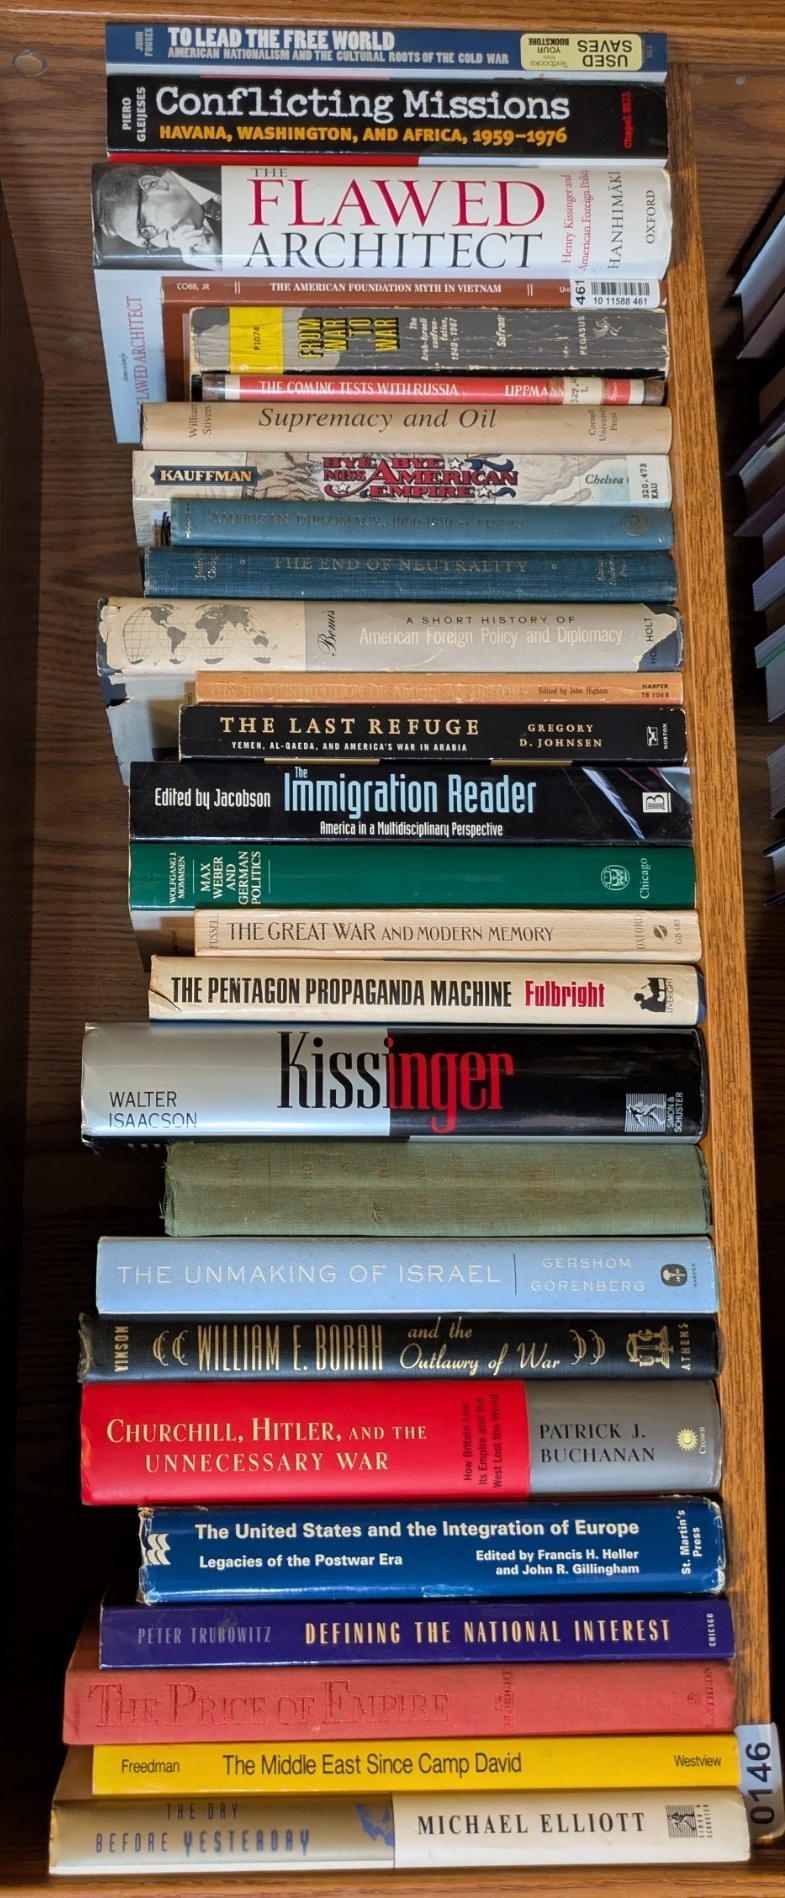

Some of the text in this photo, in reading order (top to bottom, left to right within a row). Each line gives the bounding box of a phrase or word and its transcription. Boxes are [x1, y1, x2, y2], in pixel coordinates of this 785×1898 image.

[168, 27, 395, 51] TO LEAD THE FREE WORLD
[528, 37, 570, 46] BOOKSTORE
[577, 39, 632, 67] USED SAVES
[122, 97, 132, 130] PIERO
[137, 87, 146, 142] GLEIJESES
[156, 87, 570, 124] Conflicting Missions
[159, 125, 233, 143] HAVANA,
[237, 127, 358, 144] WASHINGTON,
[362, 128, 398, 142] AND
[403, 129, 468, 144] AFRICA,
[251, 168, 288, 177] THE
[247, 178, 545, 227] FLAWED
[645, 189, 656, 244] OXFORD
[242, 232, 543, 269] ARCHITECT
[177, 282, 210, 292] COBB, JR
[575, 280, 586, 304] 461
[594, 297, 648, 306] 10 11588 461
[298, 317, 323, 359] FROM
[323, 317, 347, 352] WAR
[349, 317, 373, 337] TO
[375, 317, 400, 352] WAR
[189, 403, 198, 438] William
[202, 405, 212, 435] Stivers
[259, 407, 496, 433] Supremacy and Oil
[159, 470, 252, 482] KAUFFMAN
[323, 457, 445, 469] BYE BYE
[323, 459, 518, 486] MISS AMERICAN
[368, 485, 475, 498] EMPIRE
[585, 474, 624, 485] Chelsea
[317, 609, 337, 657] Bemis
[422, 616, 473, 624] SHORT
[481, 616, 547, 624] HISTORY
[557, 616, 575, 624] OF
[644, 617, 654, 642] HOLT
[220, 716, 479, 736] THE LAST REFUGE
[232, 741, 467, 751] YEMEN, AL-QAEDA, AND AMERICA'S WAR IN ARABIA
[295, 767, 308, 778] The
[284, 772, 537, 819] Immigration Reader
[320, 821, 503, 838] America in a Multidisciplinary Perspective
[200, 862, 211, 892] MAX
[213, 856, 223, 899] WEBER
[226, 863, 236, 891] AND
[238, 851, 249, 905] GERMAN
[251, 850, 261, 905] POLITICS
[639, 857, 650, 899] Chicago
[227, 922, 553, 942] THE GREAT WAR AND MODERN MEMORY
[171, 977, 605, 1008] THE PENTAGON PROPAGANDA MACHINE Fulbright
[277, 1031, 514, 1134] Kissinger
[109, 1091, 177, 1107] WALTER
[109, 1112, 197, 1128] ISAACSON
[675, 1092, 683, 1133] SCHUSTER
[117, 1264, 501, 1284] THE UNMAKING OF ISRAEL
[542, 1258, 631, 1269] GERSHOM
[531, 1280, 645, 1292] GORENBERG
[114, 1326, 129, 1372] VINSON
[198, 1324, 383, 1372] WILLIAM E. BORAH
[678, 1322, 691, 1371] ATHENS
[107, 1417, 427, 1443] CHURCHILL, HITLER, AND THE
[145, 1452, 388, 1473] UNNECESSARY WAR
[195, 1520, 640, 1540] The United States and the Integration of Europe
[676, 1509, 691, 1575] St. Martin's
[693, 1527, 702, 1557] Press
[200, 1553, 403, 1571] Legacies of the Postwar Era
[305, 1620, 670, 1644] DEFINING THE NATIONAL INTEREST
[707, 1613, 717, 1647] CHICAGO
[121, 1759, 180, 1774] Freedman
[222, 1751, 522, 1778] The Middle East Since Camp David
[674, 1754, 721, 1767] Westview
[745, 1741, 775, 1826] 0146
[166, 1802, 239, 1820] THE DAY
[417, 1812, 645, 1835] MICHAEL ELLIOTT
[96, 1829, 310, 1857] BEFORE YESTERDAY
